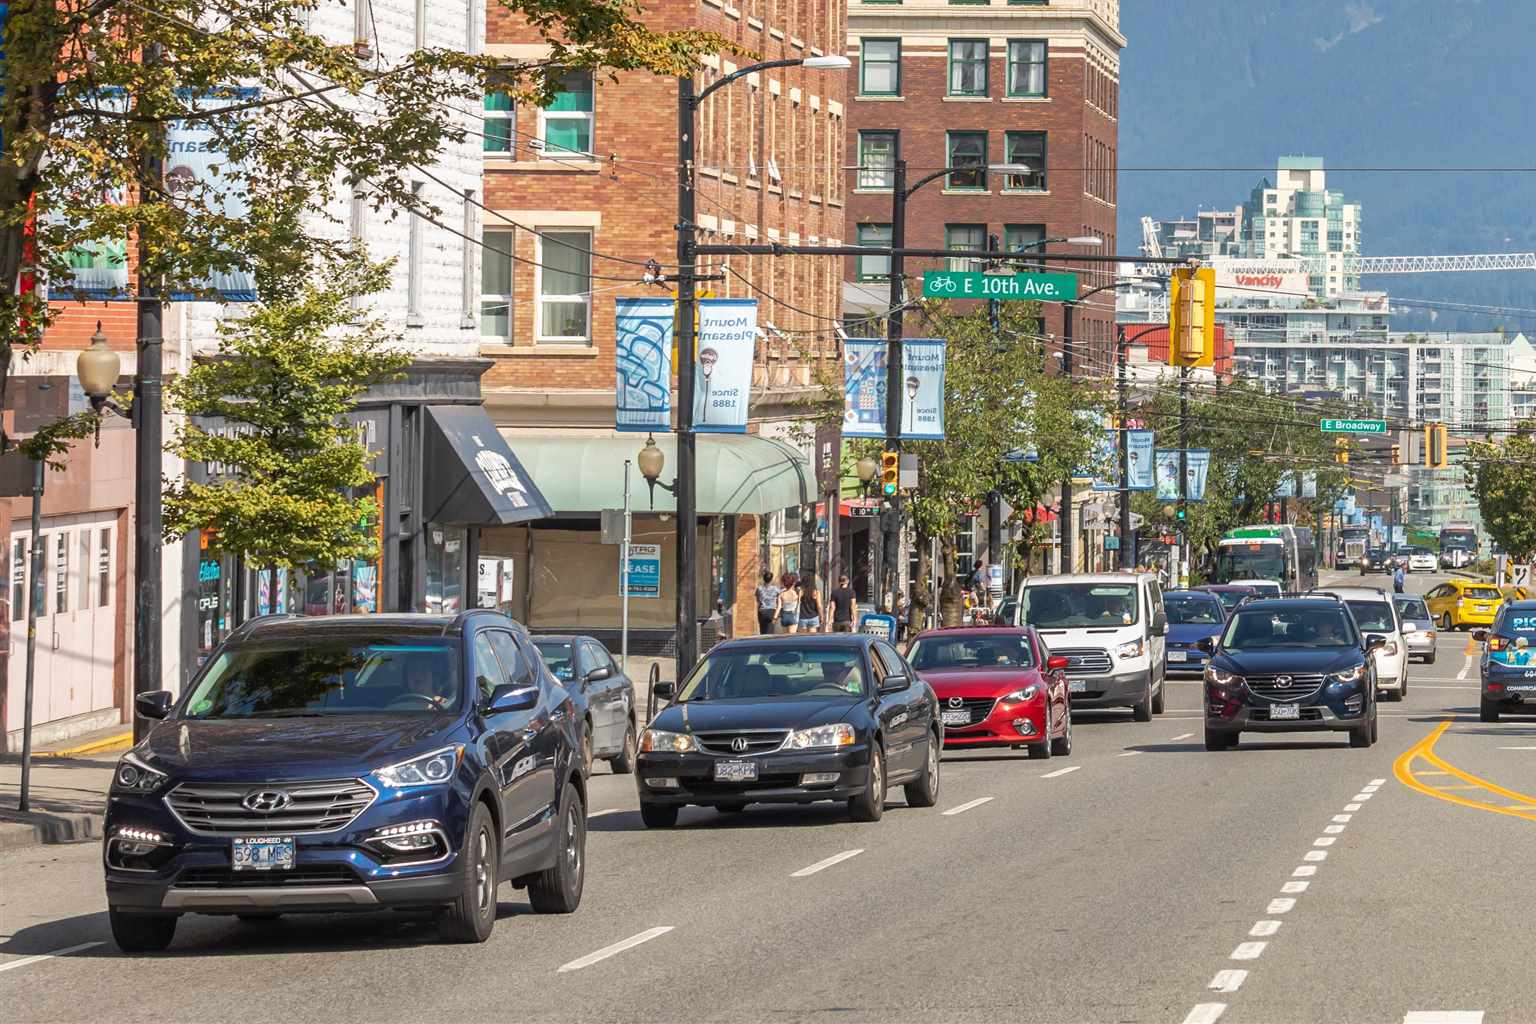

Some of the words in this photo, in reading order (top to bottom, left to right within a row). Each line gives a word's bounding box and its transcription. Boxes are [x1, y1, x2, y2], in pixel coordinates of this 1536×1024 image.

[964, 278, 973, 293] E
[981, 278, 1019, 294] 10th
[1024, 278, 1060, 295] Ave.
[1236, 275, 1283, 289] Vancity
[1325, 421, 1332, 429] E
[1335, 421, 1381, 432] Broadway
[235, 847, 260, 862] 598
